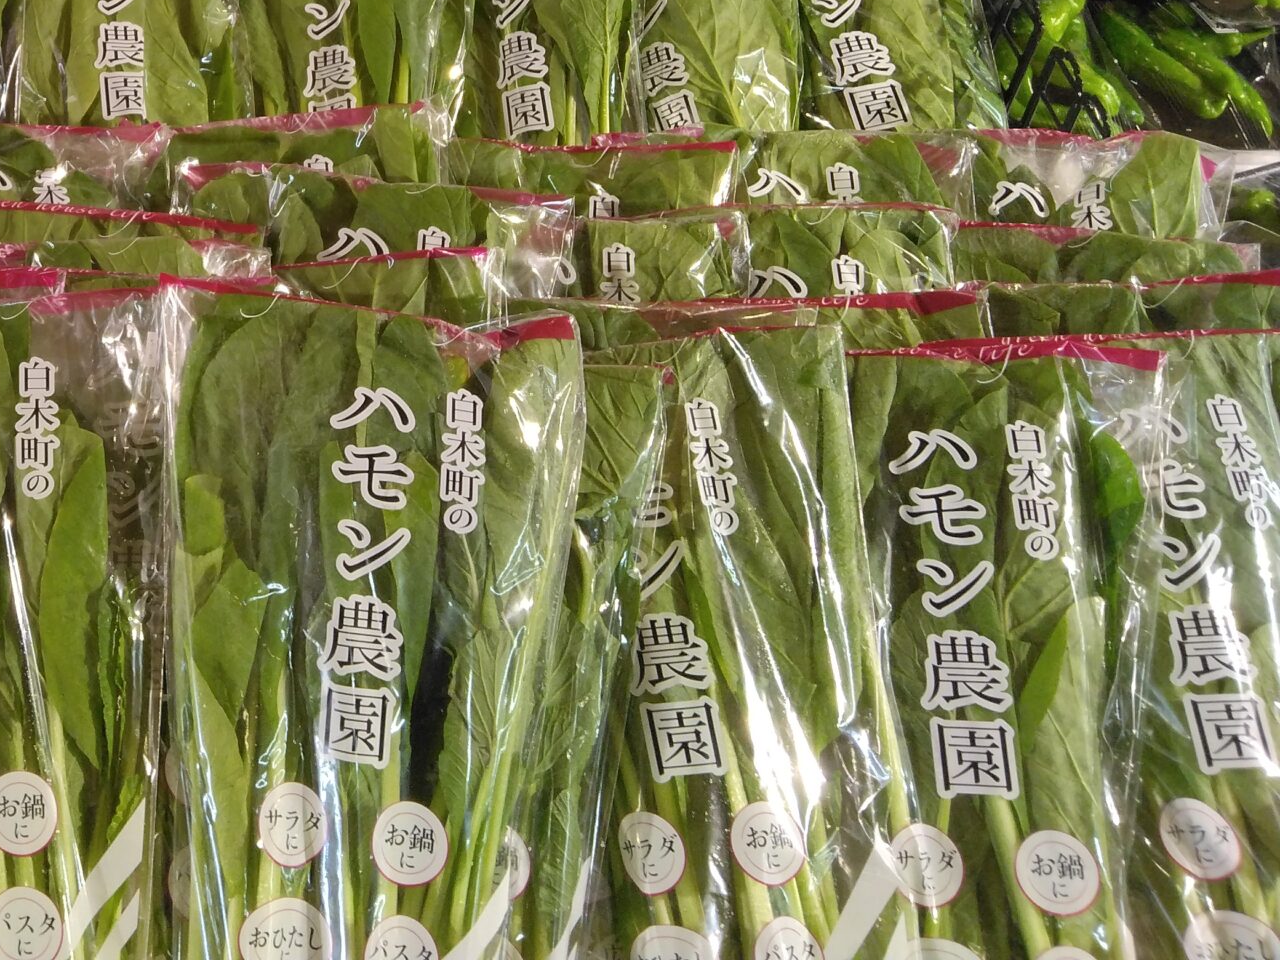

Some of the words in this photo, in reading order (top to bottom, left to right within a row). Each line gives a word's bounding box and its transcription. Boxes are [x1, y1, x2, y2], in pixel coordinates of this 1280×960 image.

[15, 356, 60, 500] 白木町の
[439, 388, 487, 535] 白木町の
[684, 397, 739, 536] 白木町の
[1004, 420, 1061, 561] 白木町の
[317, 386, 416, 769] ハモン農園
[888, 428, 1019, 799] ハモン農園
[12, 821, 30, 840] に
[264, 808, 322, 831] サラダ
[284, 832, 299, 851] に
[384, 823, 436, 854] お鍋
[399, 852, 416, 870] に
[766, 852, 782, 870] に
[1031, 852, 1084, 881] お鍋
[1052, 881, 1069, 900] に
[18, 939, 33, 957] に
[248, 926, 322, 950] おひたし
